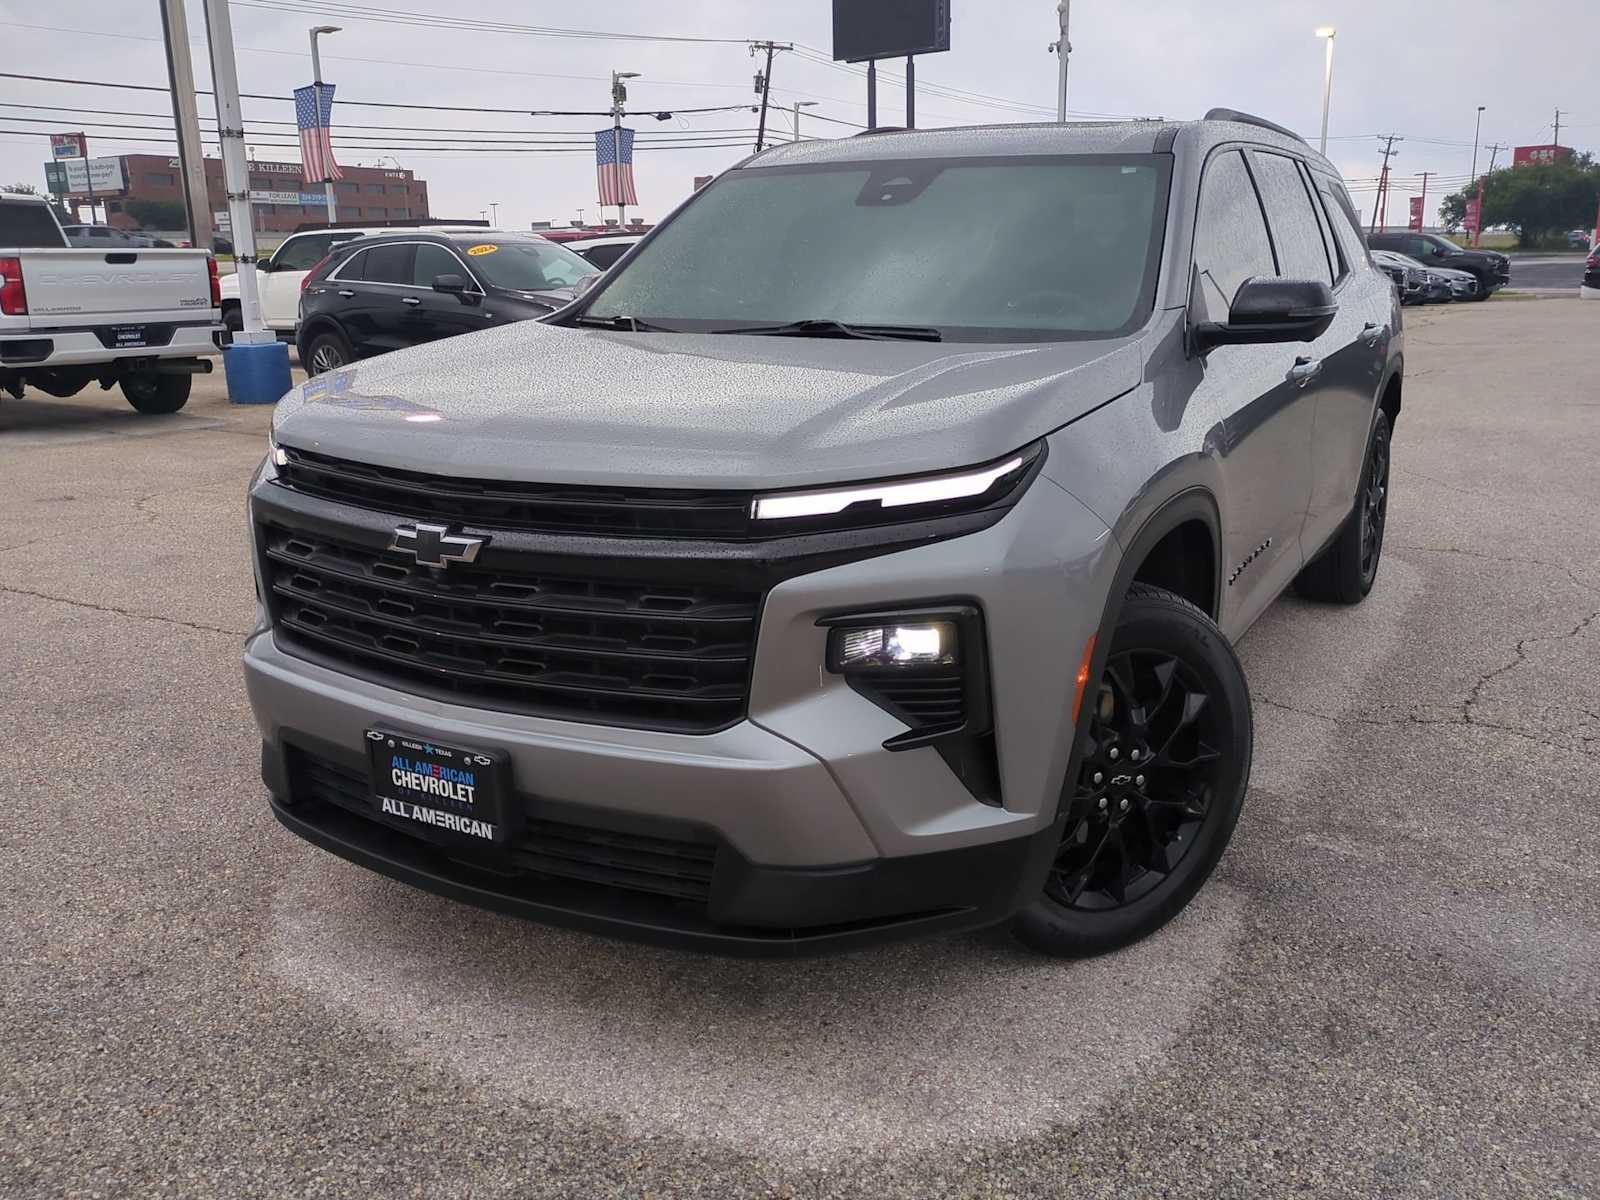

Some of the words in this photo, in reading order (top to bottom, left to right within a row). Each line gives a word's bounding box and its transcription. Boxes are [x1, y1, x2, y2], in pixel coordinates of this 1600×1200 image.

[259, 164, 302, 174] KILLEEN
[470, 245, 496, 255] 2024
[39, 272, 199, 286] CHEVROLET
[401, 741, 423, 751] KILLEEN
[435, 748, 452, 757] TEXAS
[392, 755, 412, 771] ALL
[415, 761, 475, 785] AMERICAN
[392, 769, 475, 804] CHEVROLET
[382, 797, 410, 818] ALL
[412, 806, 493, 840] AMERICAN
